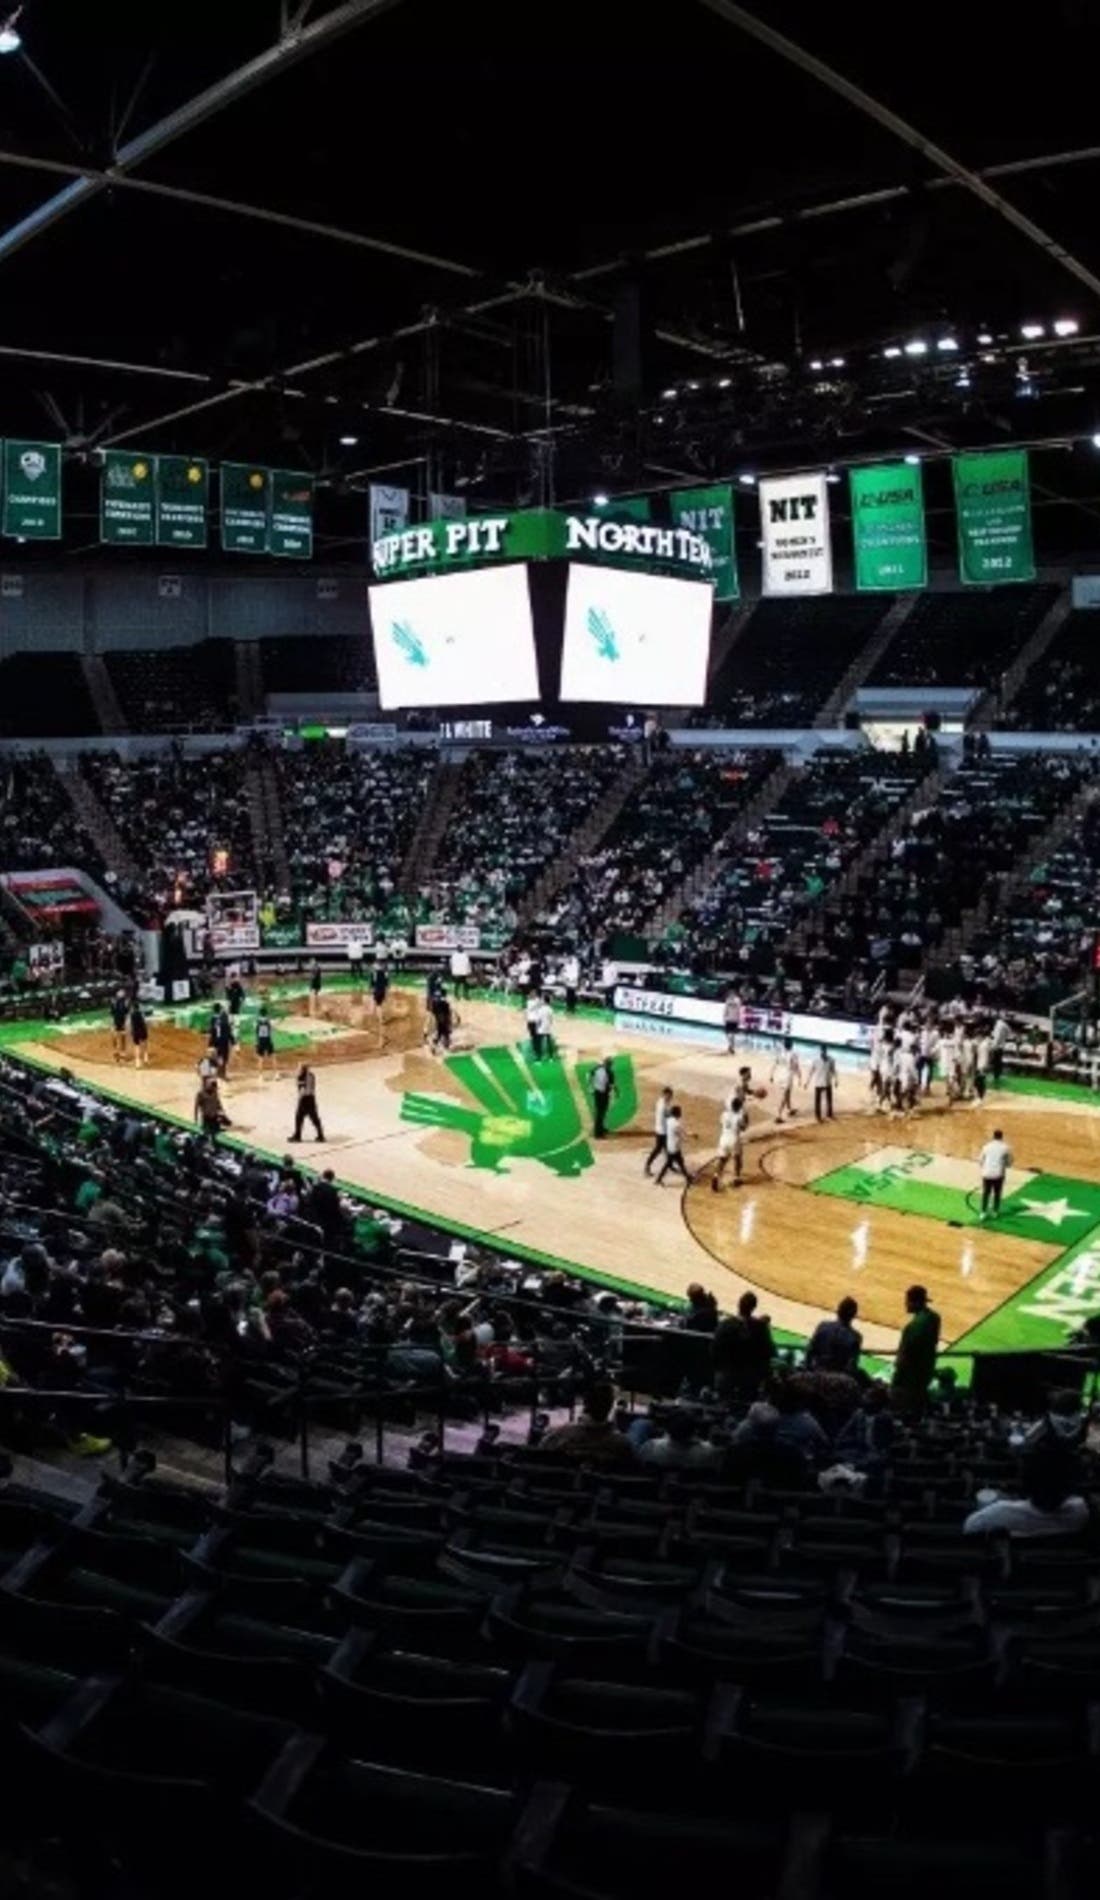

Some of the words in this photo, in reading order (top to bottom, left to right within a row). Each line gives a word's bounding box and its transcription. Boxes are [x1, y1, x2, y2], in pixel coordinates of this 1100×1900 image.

[769, 494, 818, 523] NIT
[446, 518, 508, 554] PIT
[565, 515, 674, 557] NORTH
